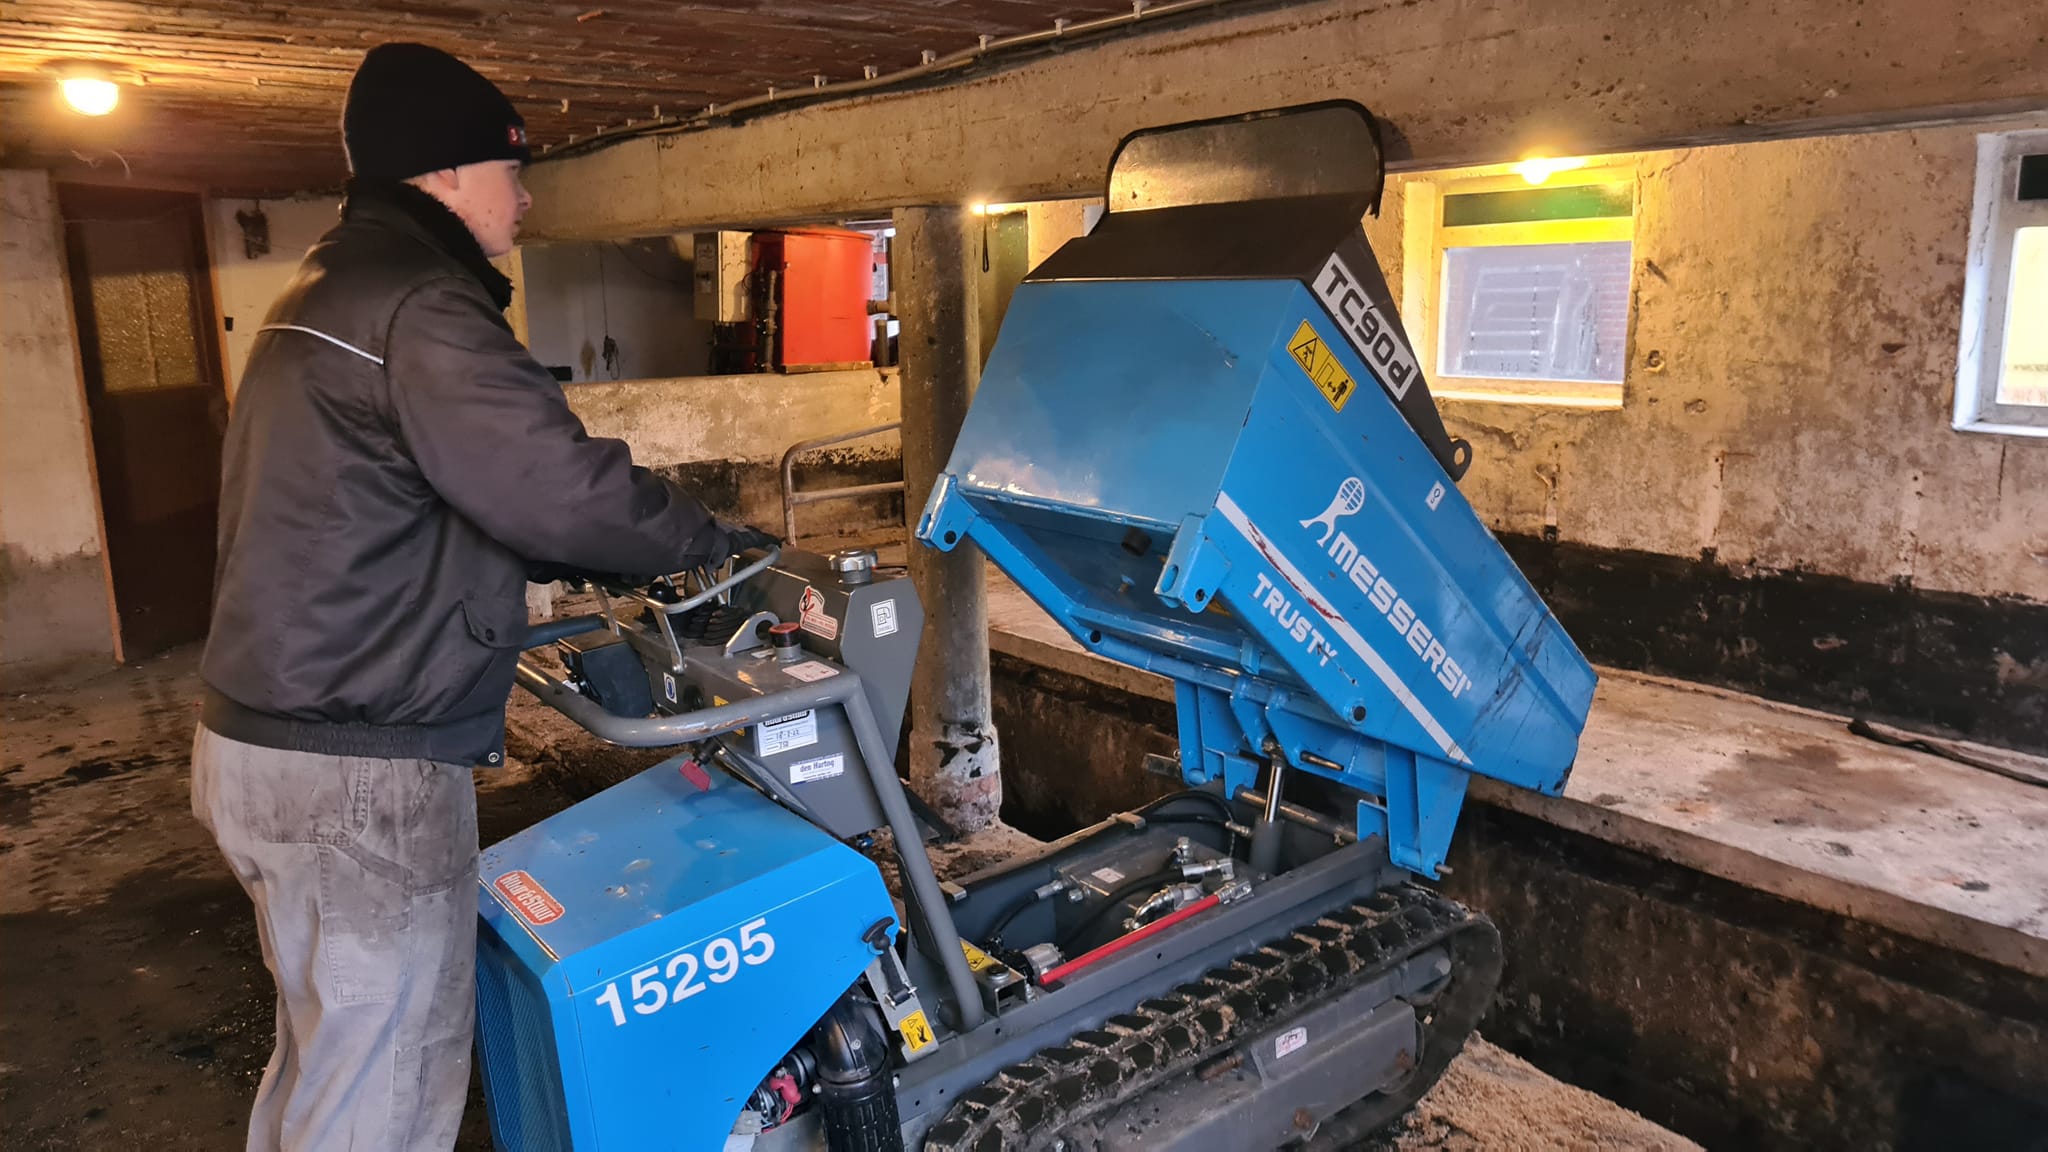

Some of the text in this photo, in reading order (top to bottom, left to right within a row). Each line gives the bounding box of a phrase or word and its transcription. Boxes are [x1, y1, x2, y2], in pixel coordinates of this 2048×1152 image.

[1325, 263, 1413, 389] TC90d
[1253, 572, 1338, 667] TRUSTY
[595, 917, 776, 1027] 15295
